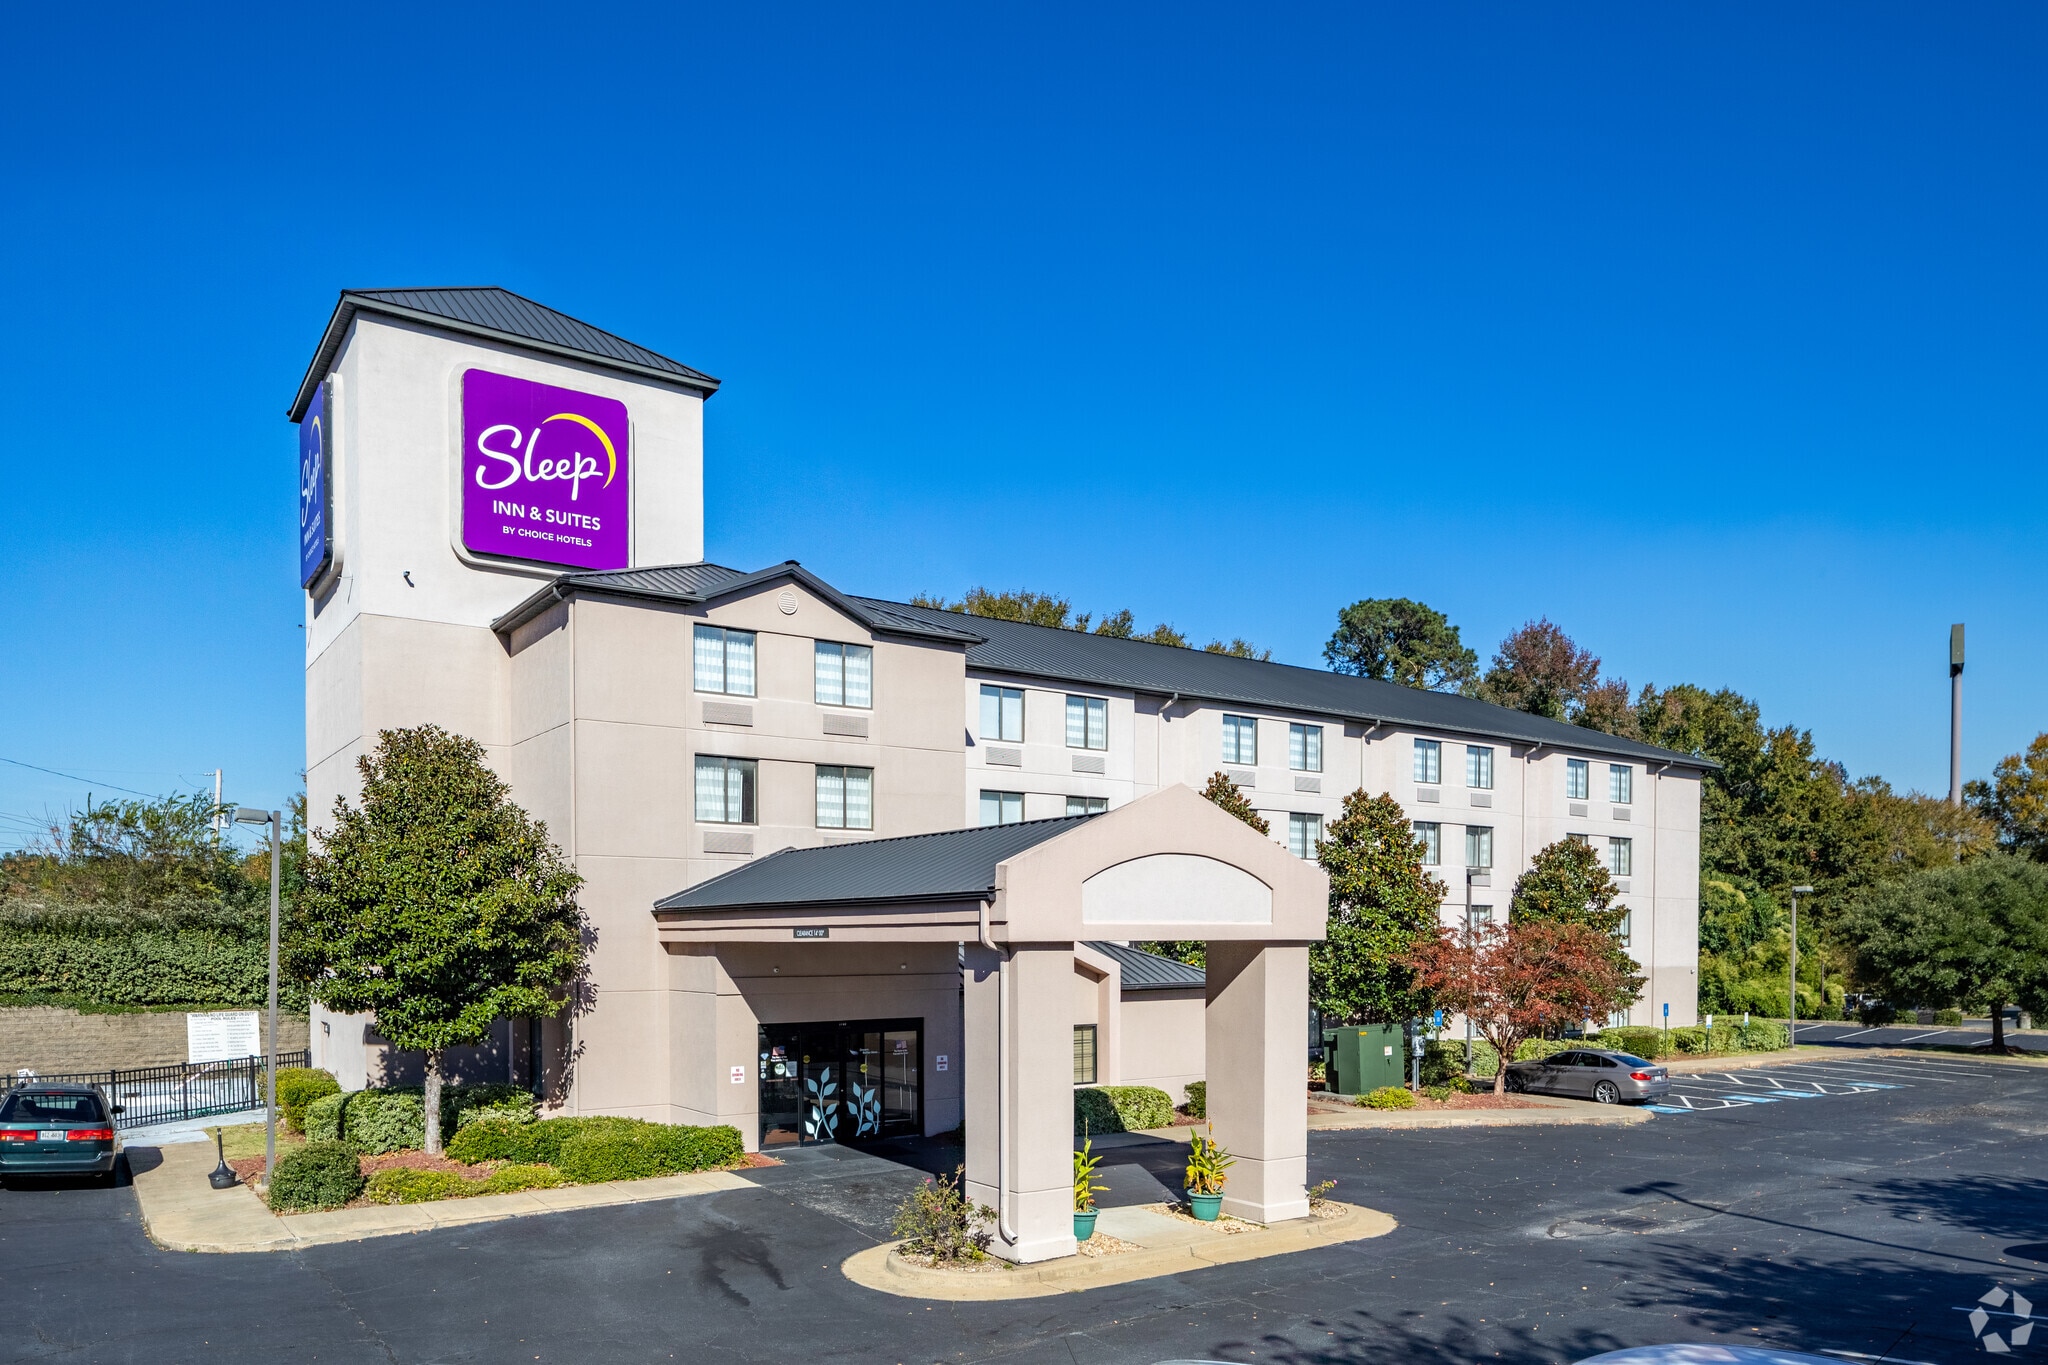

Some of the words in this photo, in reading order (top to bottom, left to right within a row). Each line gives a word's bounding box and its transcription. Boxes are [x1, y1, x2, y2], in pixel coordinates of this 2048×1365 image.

[301, 449, 321, 528] Sleep
[475, 424, 604, 501] Sleep
[493, 500, 525, 518] INN
[529, 506, 542, 521] &
[545, 508, 601, 531] SUITES
[502, 525, 516, 535] BY
[518, 528, 555, 541] CHOICE
[556, 534, 593, 547] HOTELS
